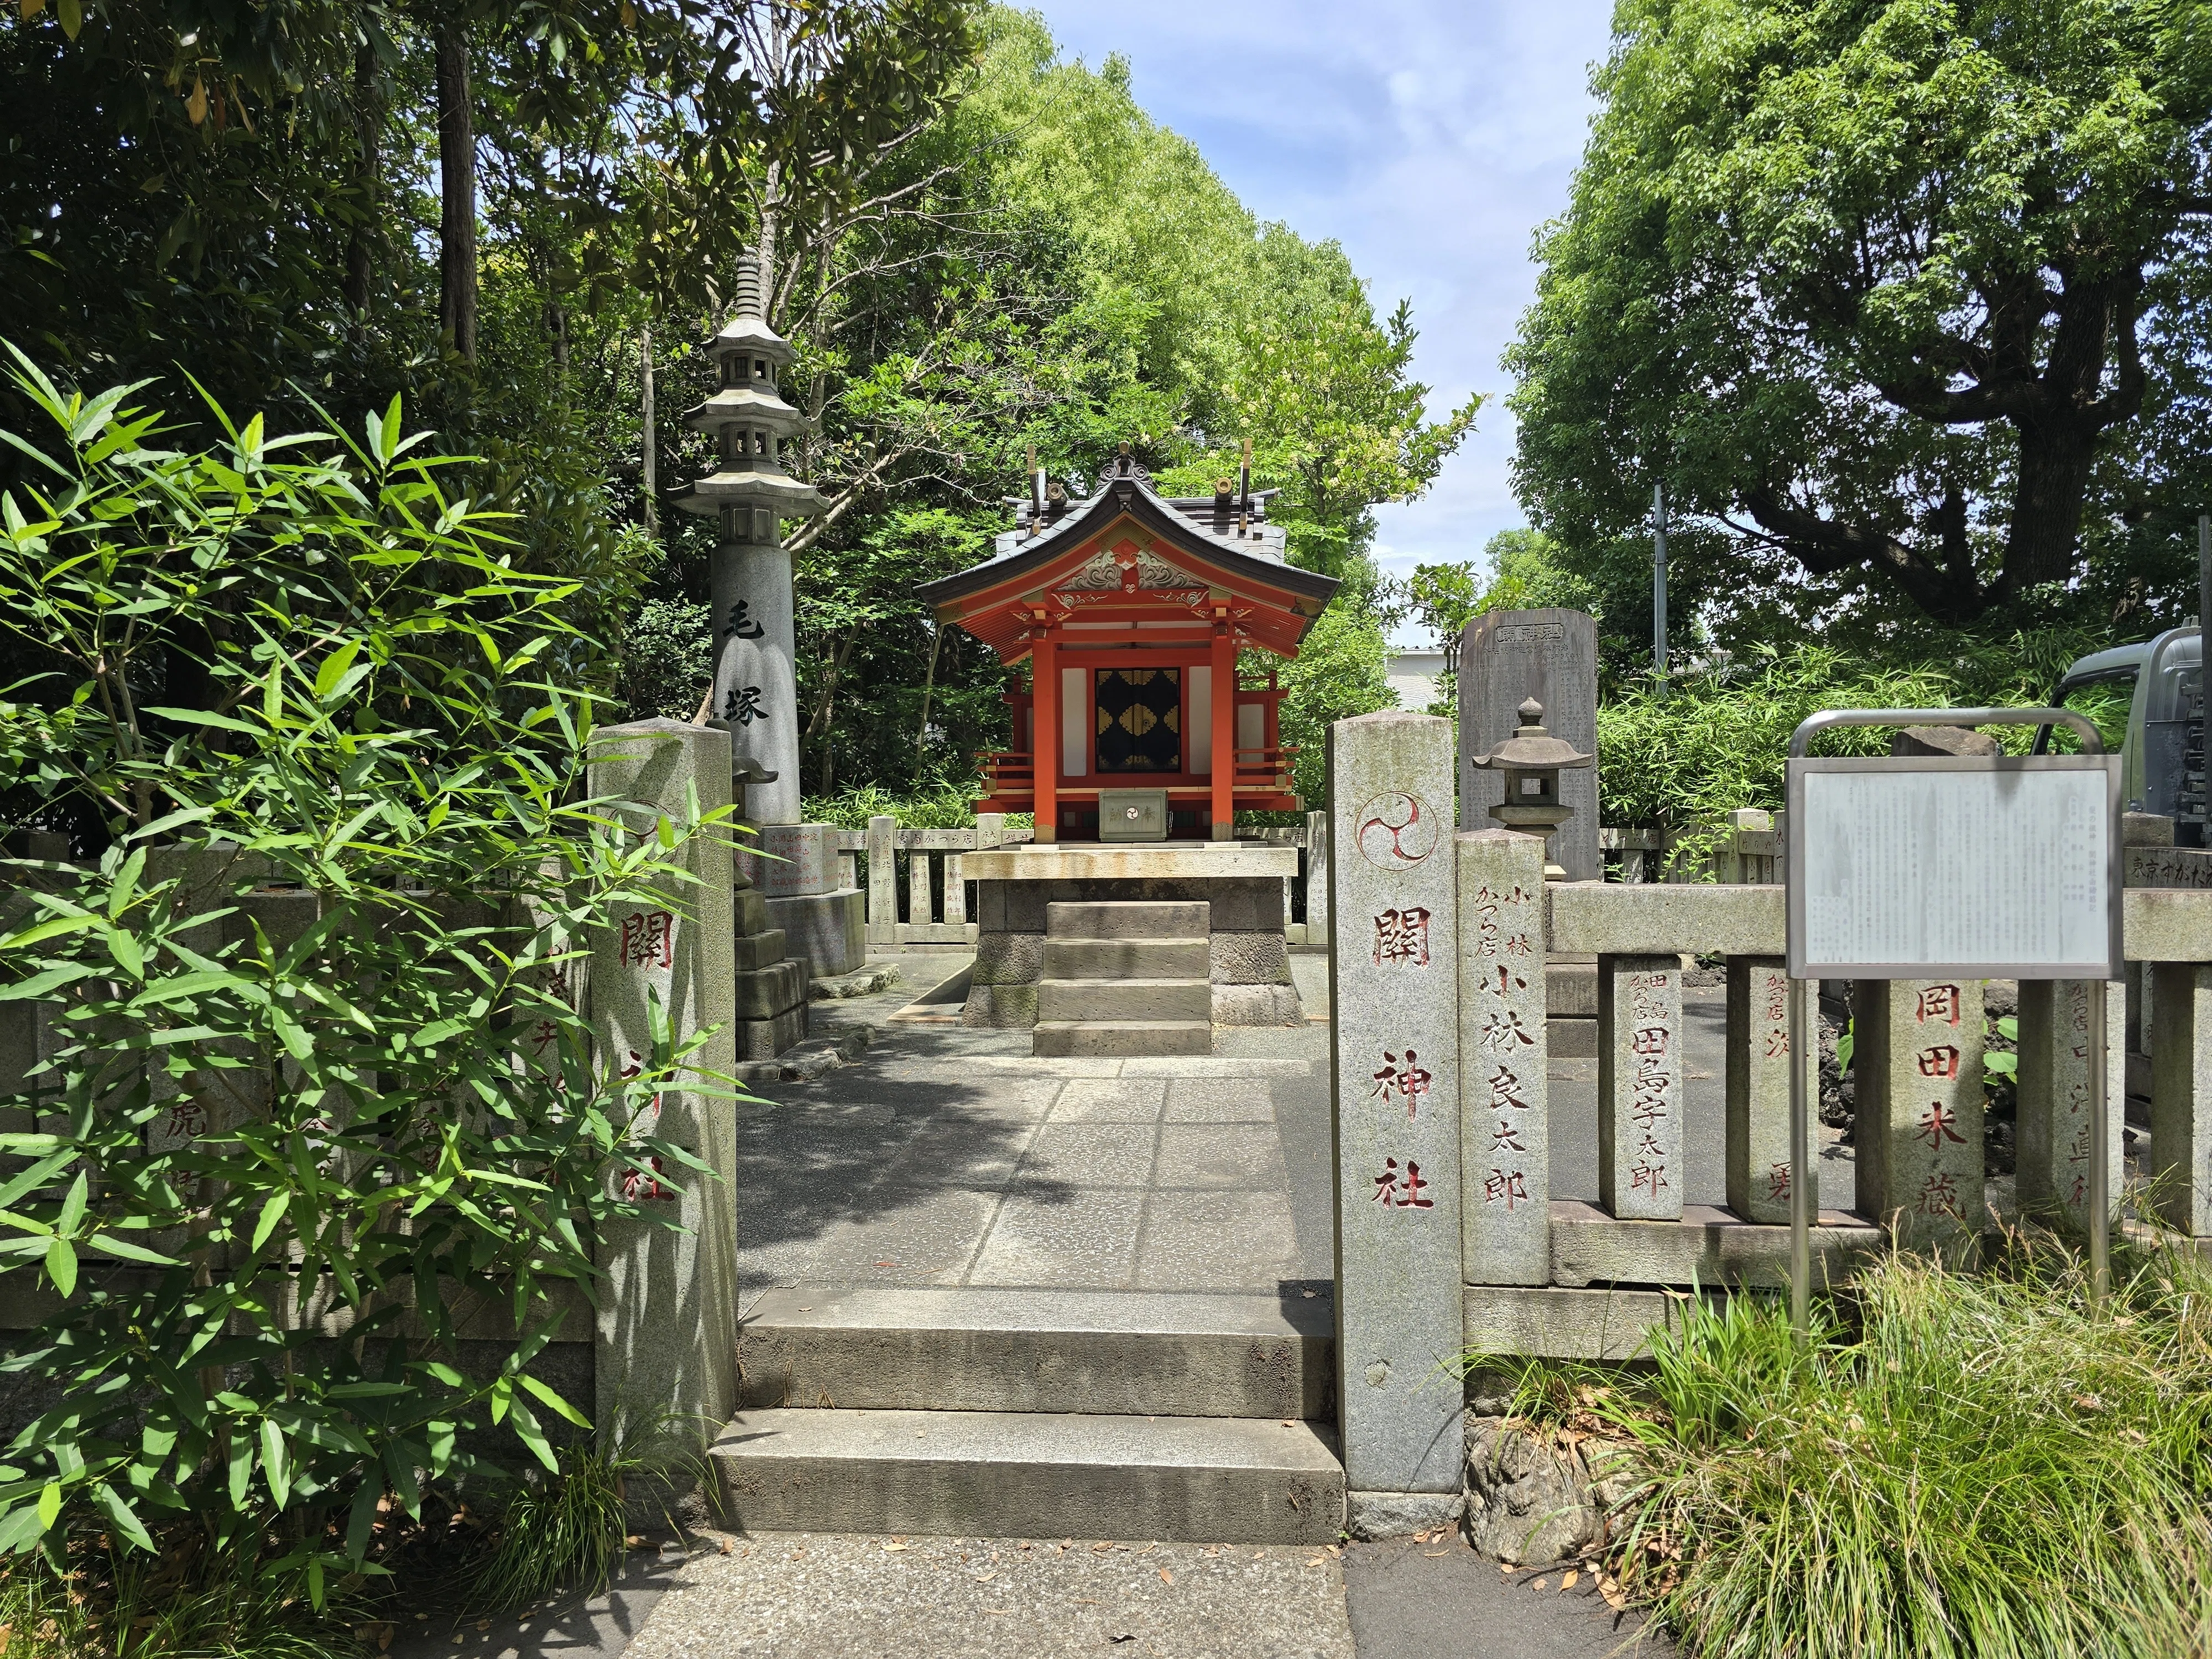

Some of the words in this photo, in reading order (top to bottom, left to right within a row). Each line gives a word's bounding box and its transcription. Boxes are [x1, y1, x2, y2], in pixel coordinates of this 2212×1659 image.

[722, 599, 769, 727] 毛塚
[1474, 886, 1499, 959] かつら店
[1504, 886, 1533, 957] 小林
[1630, 974, 1649, 1021] かつら店
[1650, 974, 1668, 1020] 田島
[1766, 974, 1785, 1021] かつら店
[1371, 906, 1435, 1209] 關神社
[1479, 965, 1535, 1212] 小林良太郎
[1913, 984, 1968, 1222] 岡田米藏
